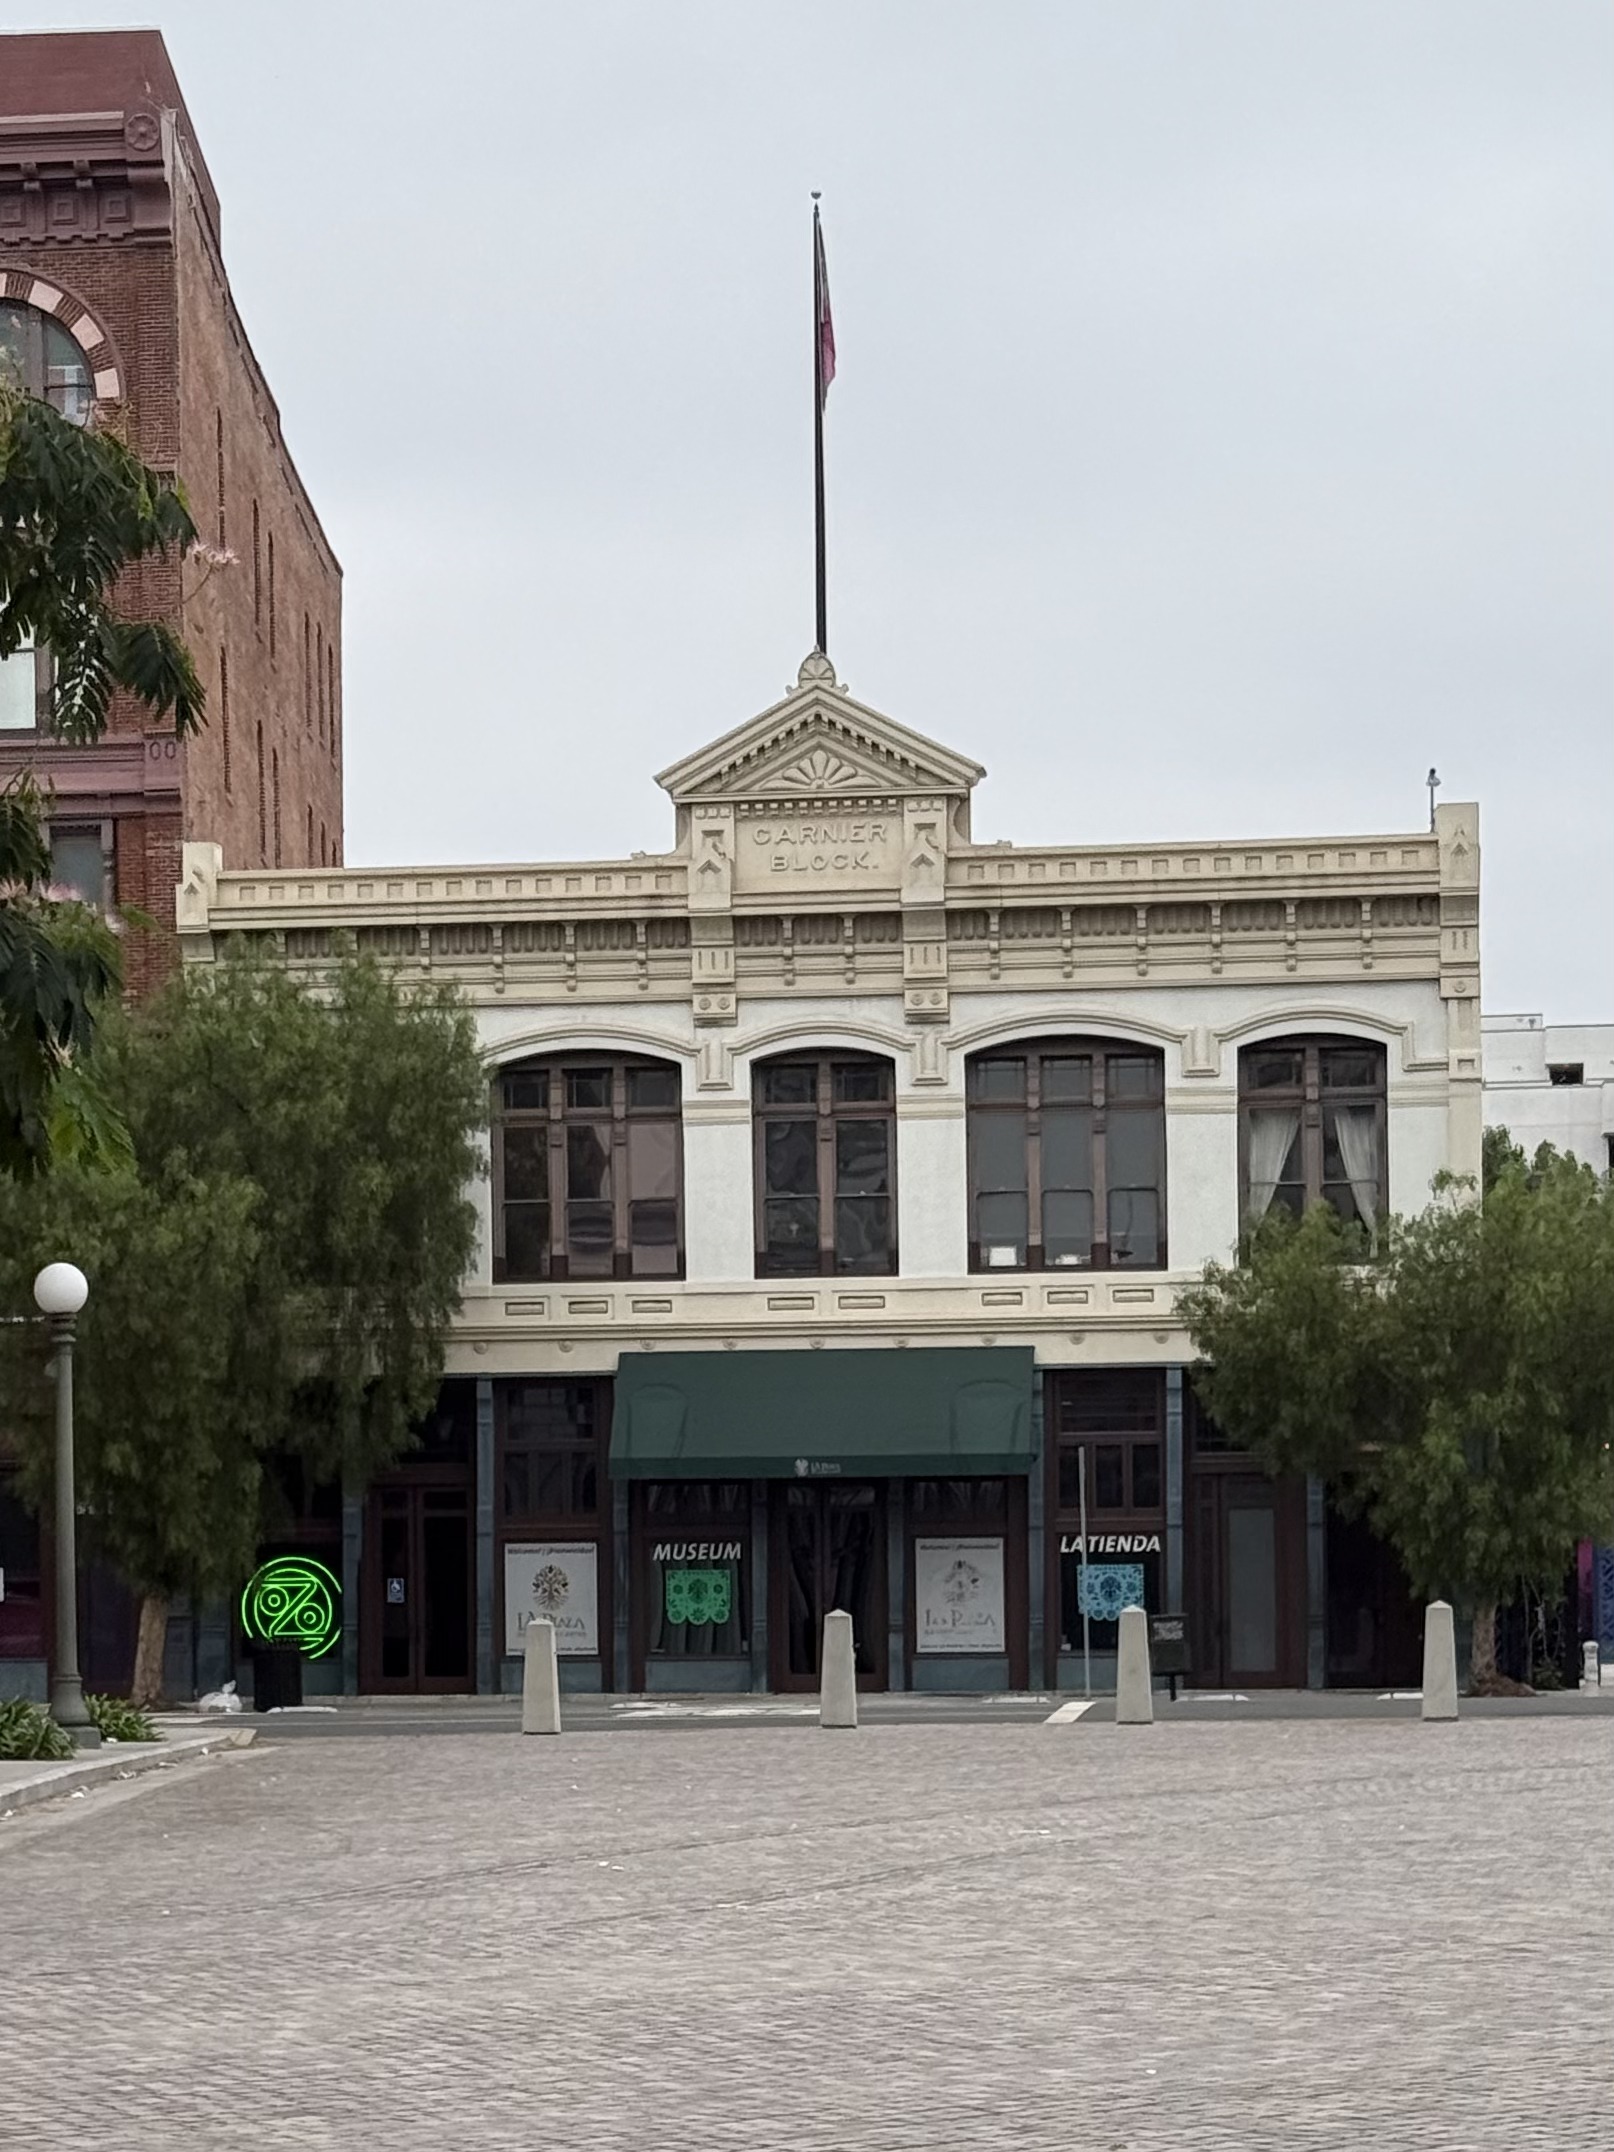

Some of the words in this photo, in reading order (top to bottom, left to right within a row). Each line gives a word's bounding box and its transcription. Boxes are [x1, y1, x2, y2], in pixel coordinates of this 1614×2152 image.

[653, 1543, 741, 1561] MUSEUM
[1060, 1535, 1084, 1553] LA
[1088, 1535, 1161, 1553] TIENDA
